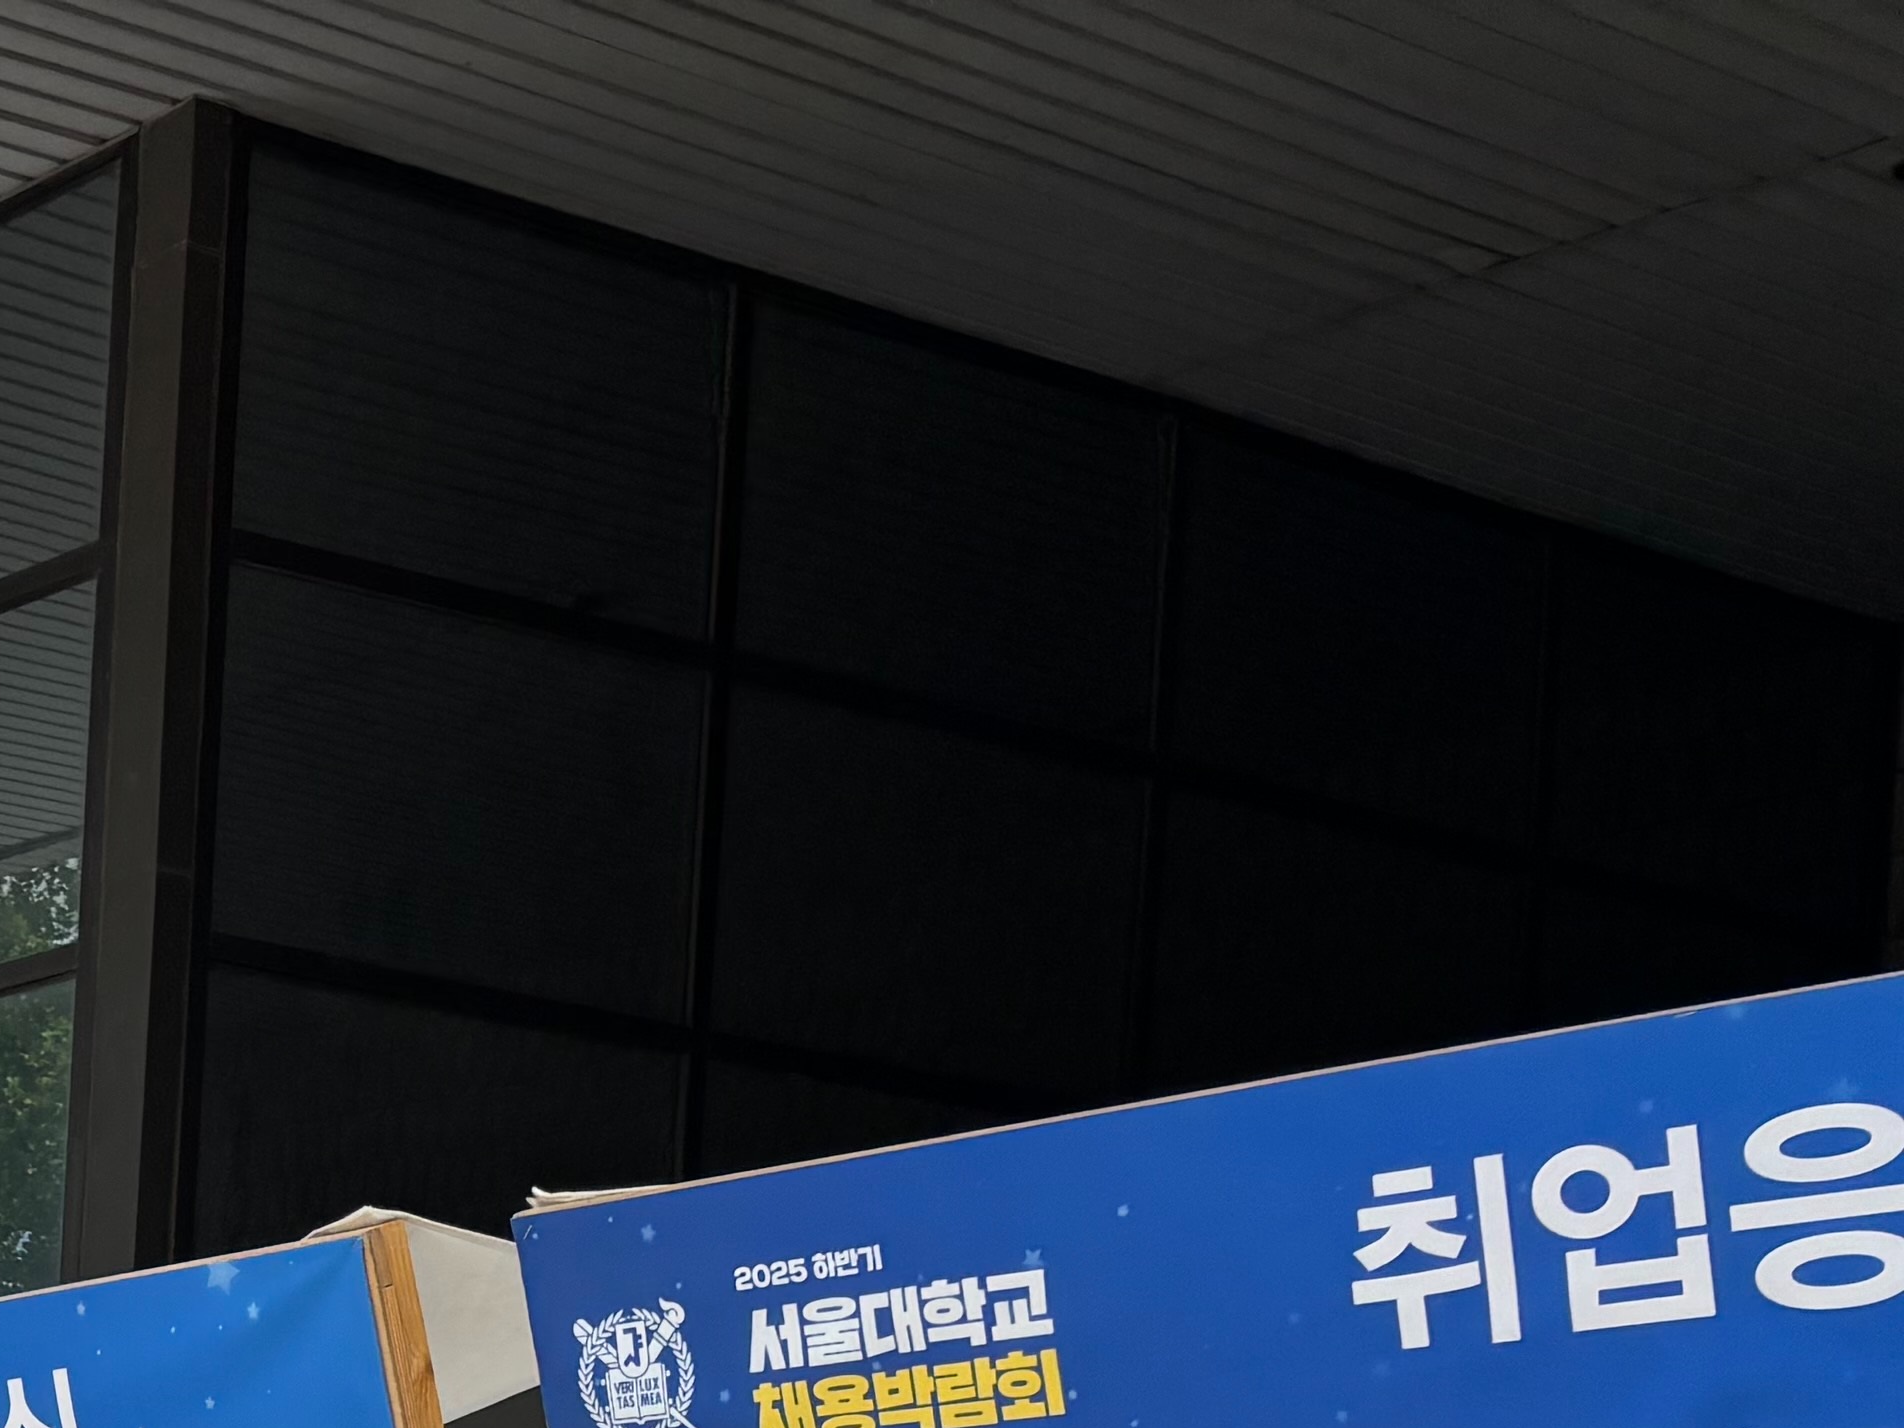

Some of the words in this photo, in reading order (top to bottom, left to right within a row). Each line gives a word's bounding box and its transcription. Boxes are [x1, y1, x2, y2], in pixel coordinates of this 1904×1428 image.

[733, 1258, 808, 1291] 2025
[811, 1244, 883, 1280] 하반기
[749, 1268, 1054, 1373] 서울대학교
